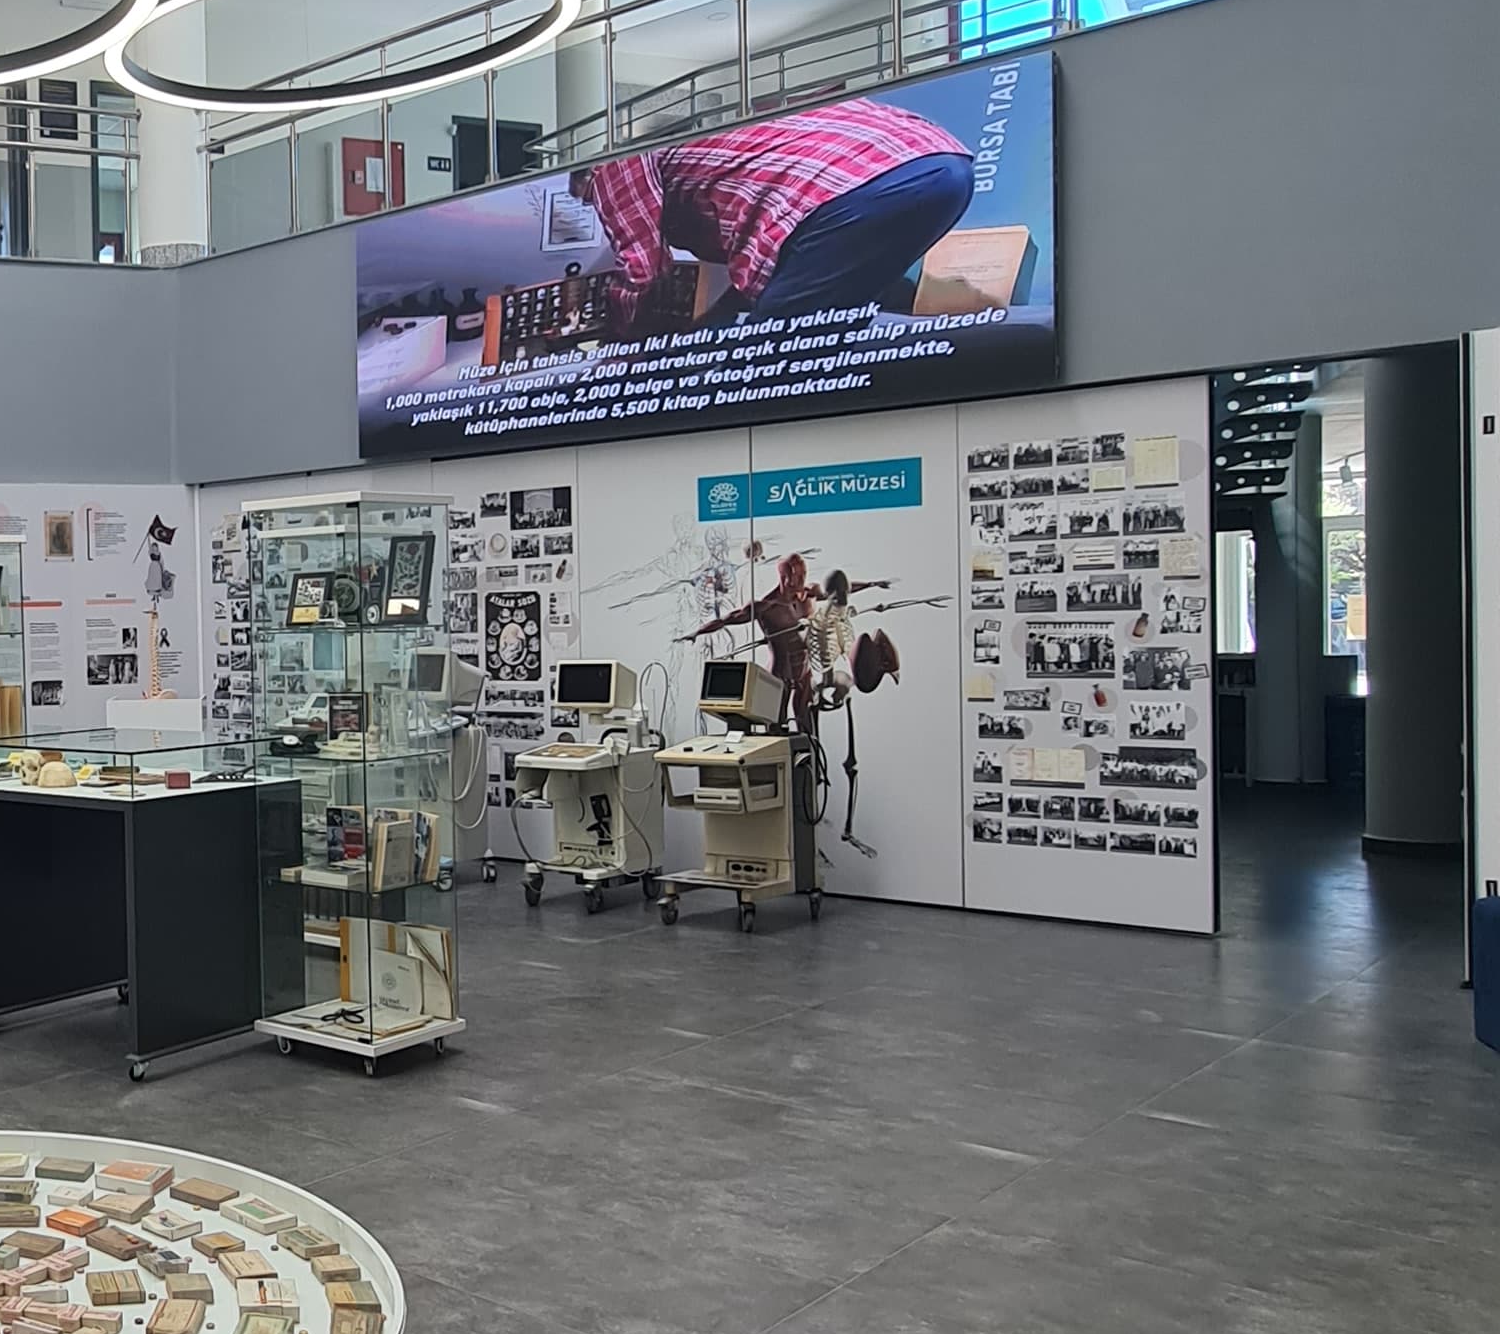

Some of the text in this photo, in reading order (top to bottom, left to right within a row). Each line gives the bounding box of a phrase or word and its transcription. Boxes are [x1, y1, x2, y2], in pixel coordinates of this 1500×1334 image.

[974, 118, 1008, 193] BURSA
[385, 307, 1006, 411] 1,000 metrekare kapalı ve 2,000 metrekare açık alana sahip müzede
[459, 365, 496, 381] Müze
[500, 359, 528, 377] için
[532, 350, 582, 369] tahsis
[586, 341, 640, 362] edilen
[671, 327, 713, 349] katlı
[715, 317, 785, 345] yapıda
[789, 301, 881, 333] yaklaşık
[411, 339, 955, 427] yaklaşık 11,700 obje, 2,000 belge ve fotoğraf sergilenmekte,
[464, 372, 872, 436] kütüphanelerinde 5,500 kitap bulunmaktadır.
[767, 470, 906, 507] SAĞLIK MÜZESİ
